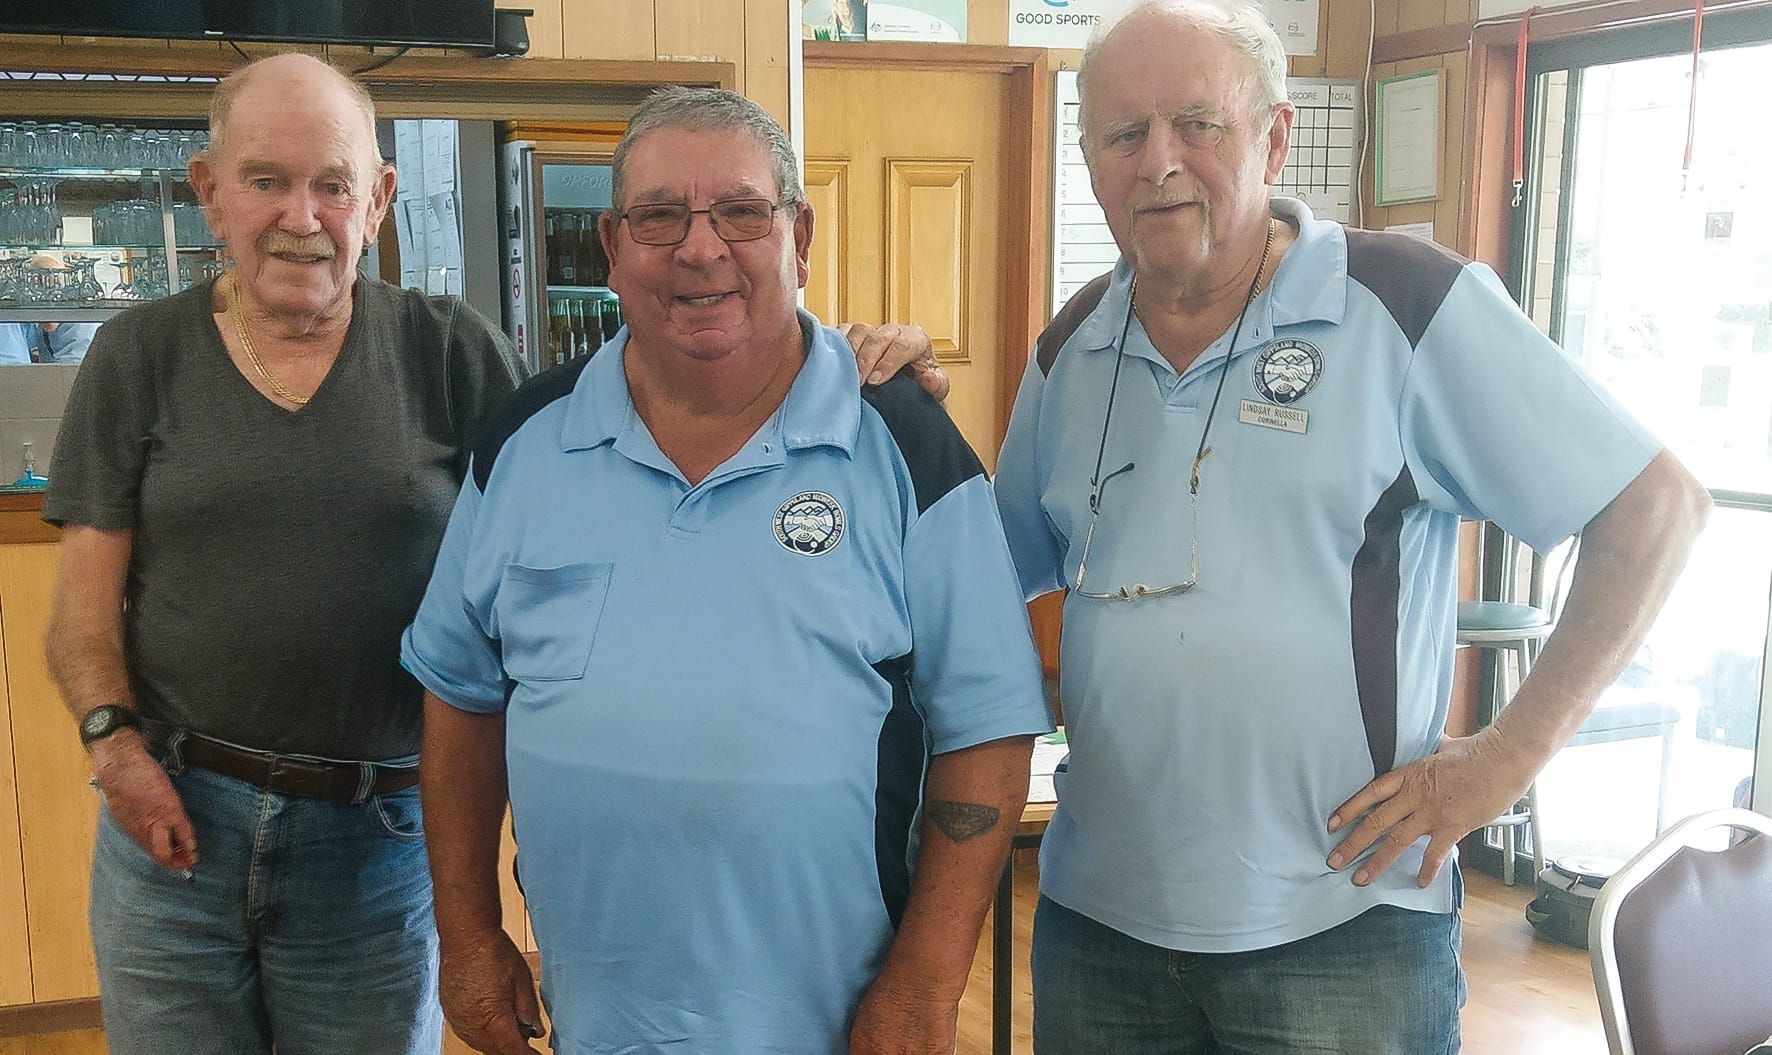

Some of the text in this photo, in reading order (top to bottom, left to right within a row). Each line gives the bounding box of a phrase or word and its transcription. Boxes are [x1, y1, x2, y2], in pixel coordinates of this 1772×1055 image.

[1016, 13, 1101, 26] GOOD SPORTS
[1331, 92, 1353, 101] TOTAL
[1242, 402, 1305, 422] LINDSAY RUSSELL
